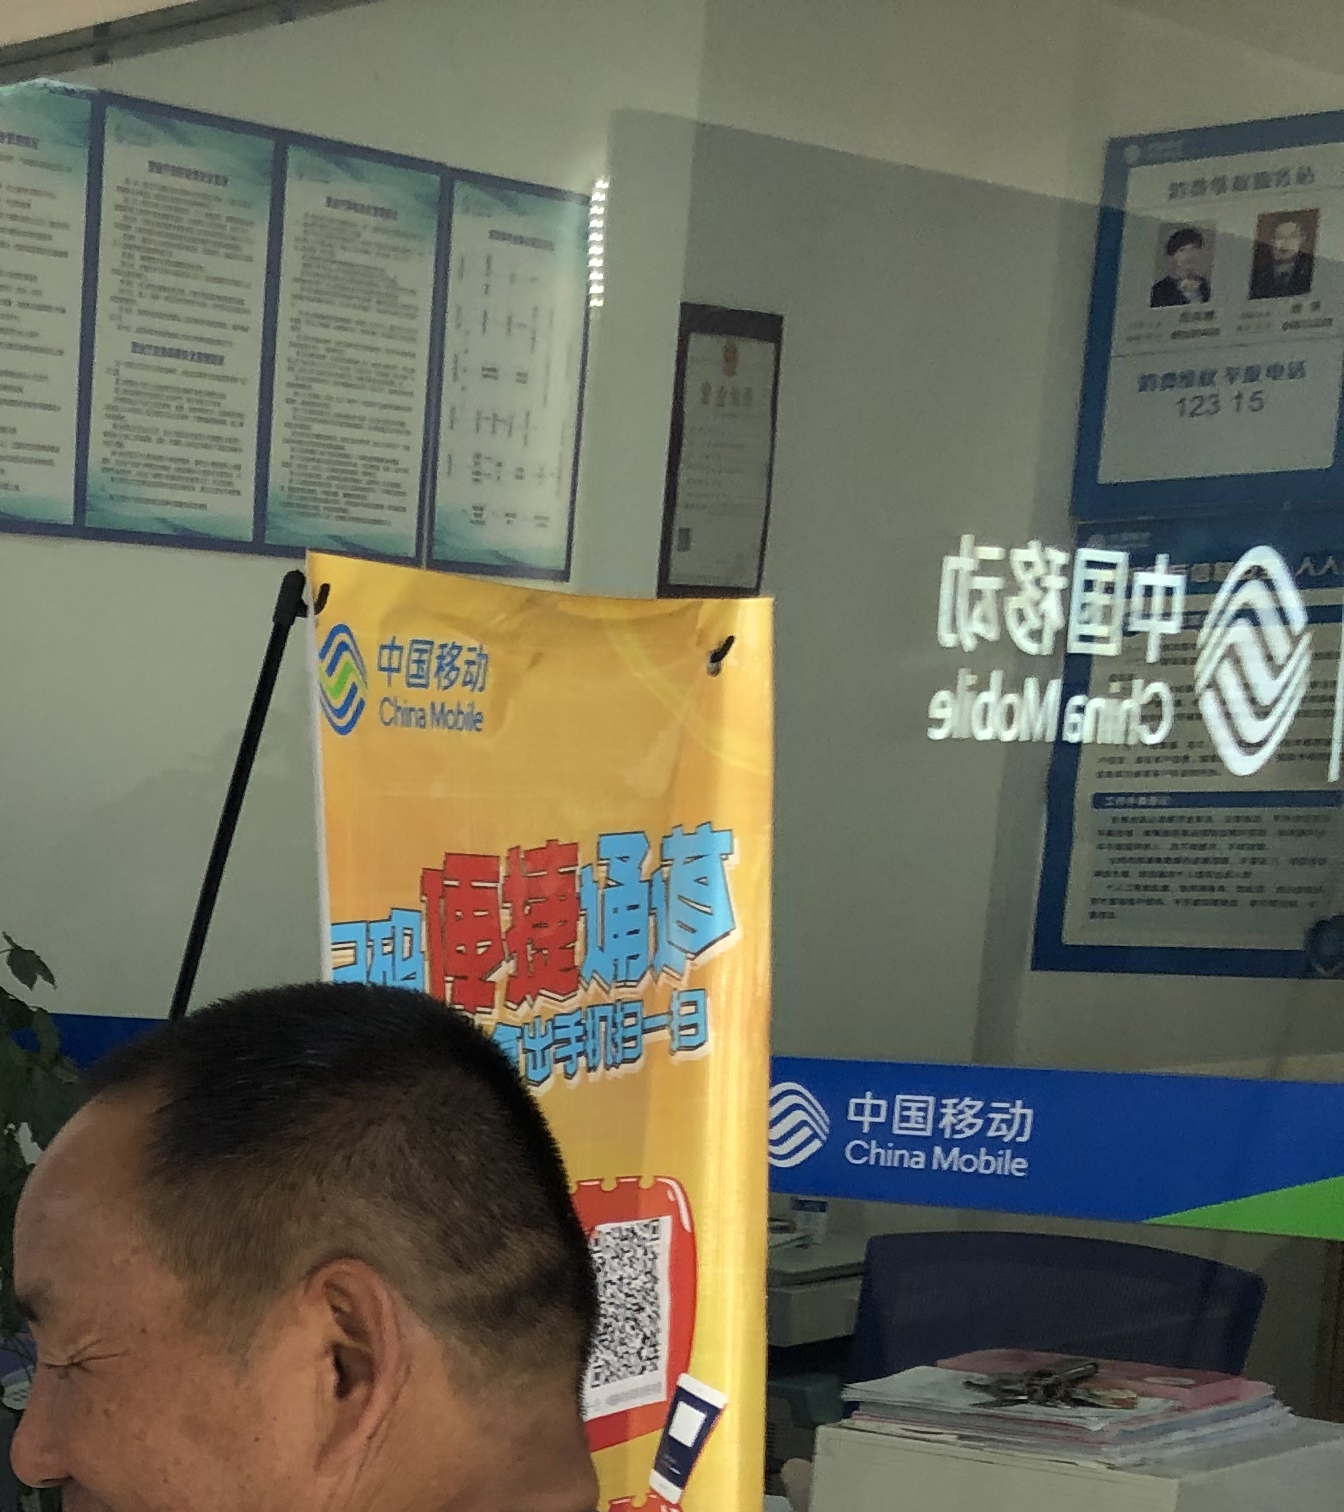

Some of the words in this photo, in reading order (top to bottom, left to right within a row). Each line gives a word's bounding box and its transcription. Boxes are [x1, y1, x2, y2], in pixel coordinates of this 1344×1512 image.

[378, 636, 489, 692] 中国移动
[379, 697, 426, 729] China
[430, 700, 484, 732] Mobile
[847, 1091, 1034, 1142] 中国移动
[844, 1140, 926, 1169] China
[931, 1145, 1029, 1177] Mobile
